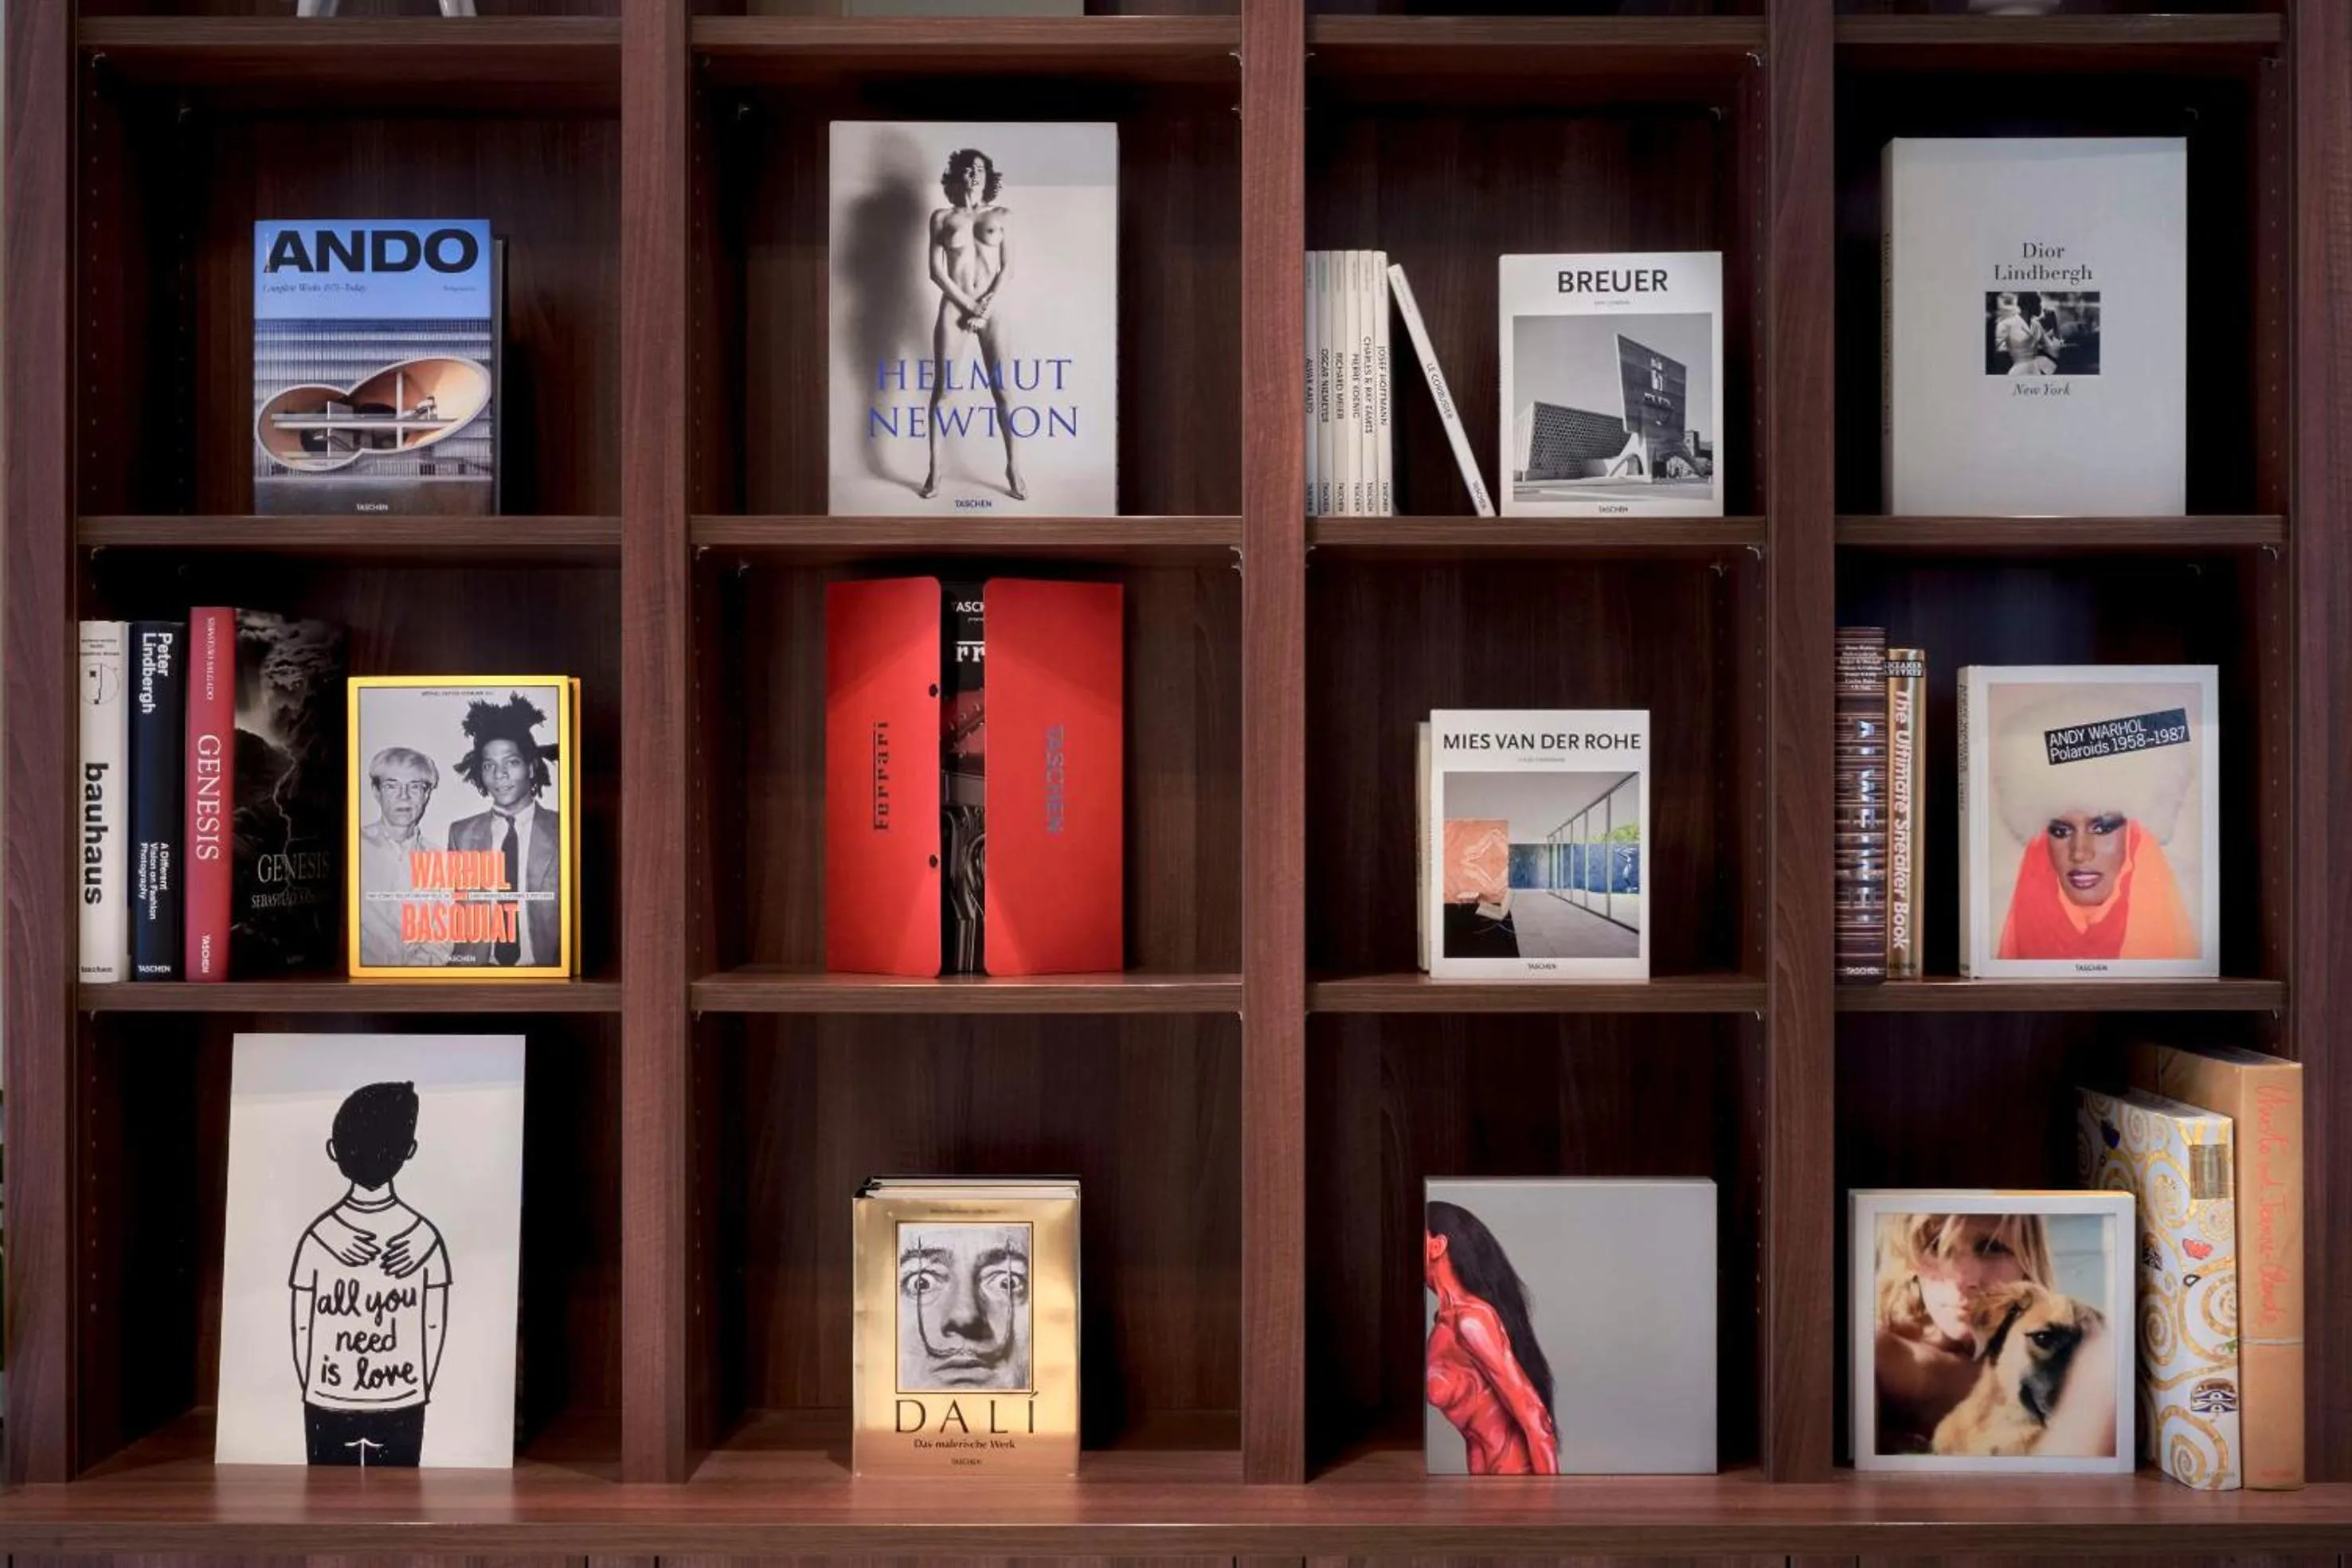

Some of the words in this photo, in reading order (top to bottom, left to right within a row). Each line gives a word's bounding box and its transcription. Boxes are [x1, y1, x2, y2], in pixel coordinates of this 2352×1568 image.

[263, 229, 479, 274] ANDO
[2022, 242, 2066, 259] Dior
[1558, 269, 1669, 293] BREUER
[1994, 264, 2092, 285] Lindbergh
[1363, 336, 1372, 375] CHARLES
[878, 358, 1072, 391] HELMUT
[2013, 384, 2041, 396] New
[2043, 383, 2071, 396] York
[868, 405, 1079, 438] NEWTON
[356, 502, 389, 510] TASCHEN
[955, 499, 992, 508] TASCHEN
[158, 633, 174, 676] Peter
[139, 632, 158, 714] Lindbergh
[1895, 690, 1912, 724] The
[1442, 733, 1490, 749] MIES
[1496, 733, 1535, 749] VAN
[1540, 733, 1579, 749] DER
[1585, 733, 1642, 749] ROHE
[2049, 730, 2085, 747] ANDY
[2088, 719, 2147, 740] WARHOL
[2049, 741, 2110, 762] Polaroids
[873, 720, 890, 831] Ferrari
[1046, 725, 1065, 833] TASCHEN
[1894, 729, 1912, 812] Ultimate
[196, 734, 221, 860] GENESIS
[84, 763, 109, 905] bauhaus
[138, 843, 148, 900] Photography
[257, 852, 330, 883] GENESIS
[409, 850, 511, 890] WARHOL
[1894, 819, 1911, 897] Sneaker
[401, 901, 520, 944] BASQUIAT
[1893, 901, 1910, 948] Book
[138, 964, 170, 973] TASCHEN
[318, 1279, 361, 1317] all
[366, 1287, 417, 1327] you
[335, 1317, 397, 1354] need
[321, 1355, 341, 1386] is
[354, 1357, 419, 1391] love
[914, 1438, 933, 1449] Das
[990, 1438, 1016, 1449] Werk
